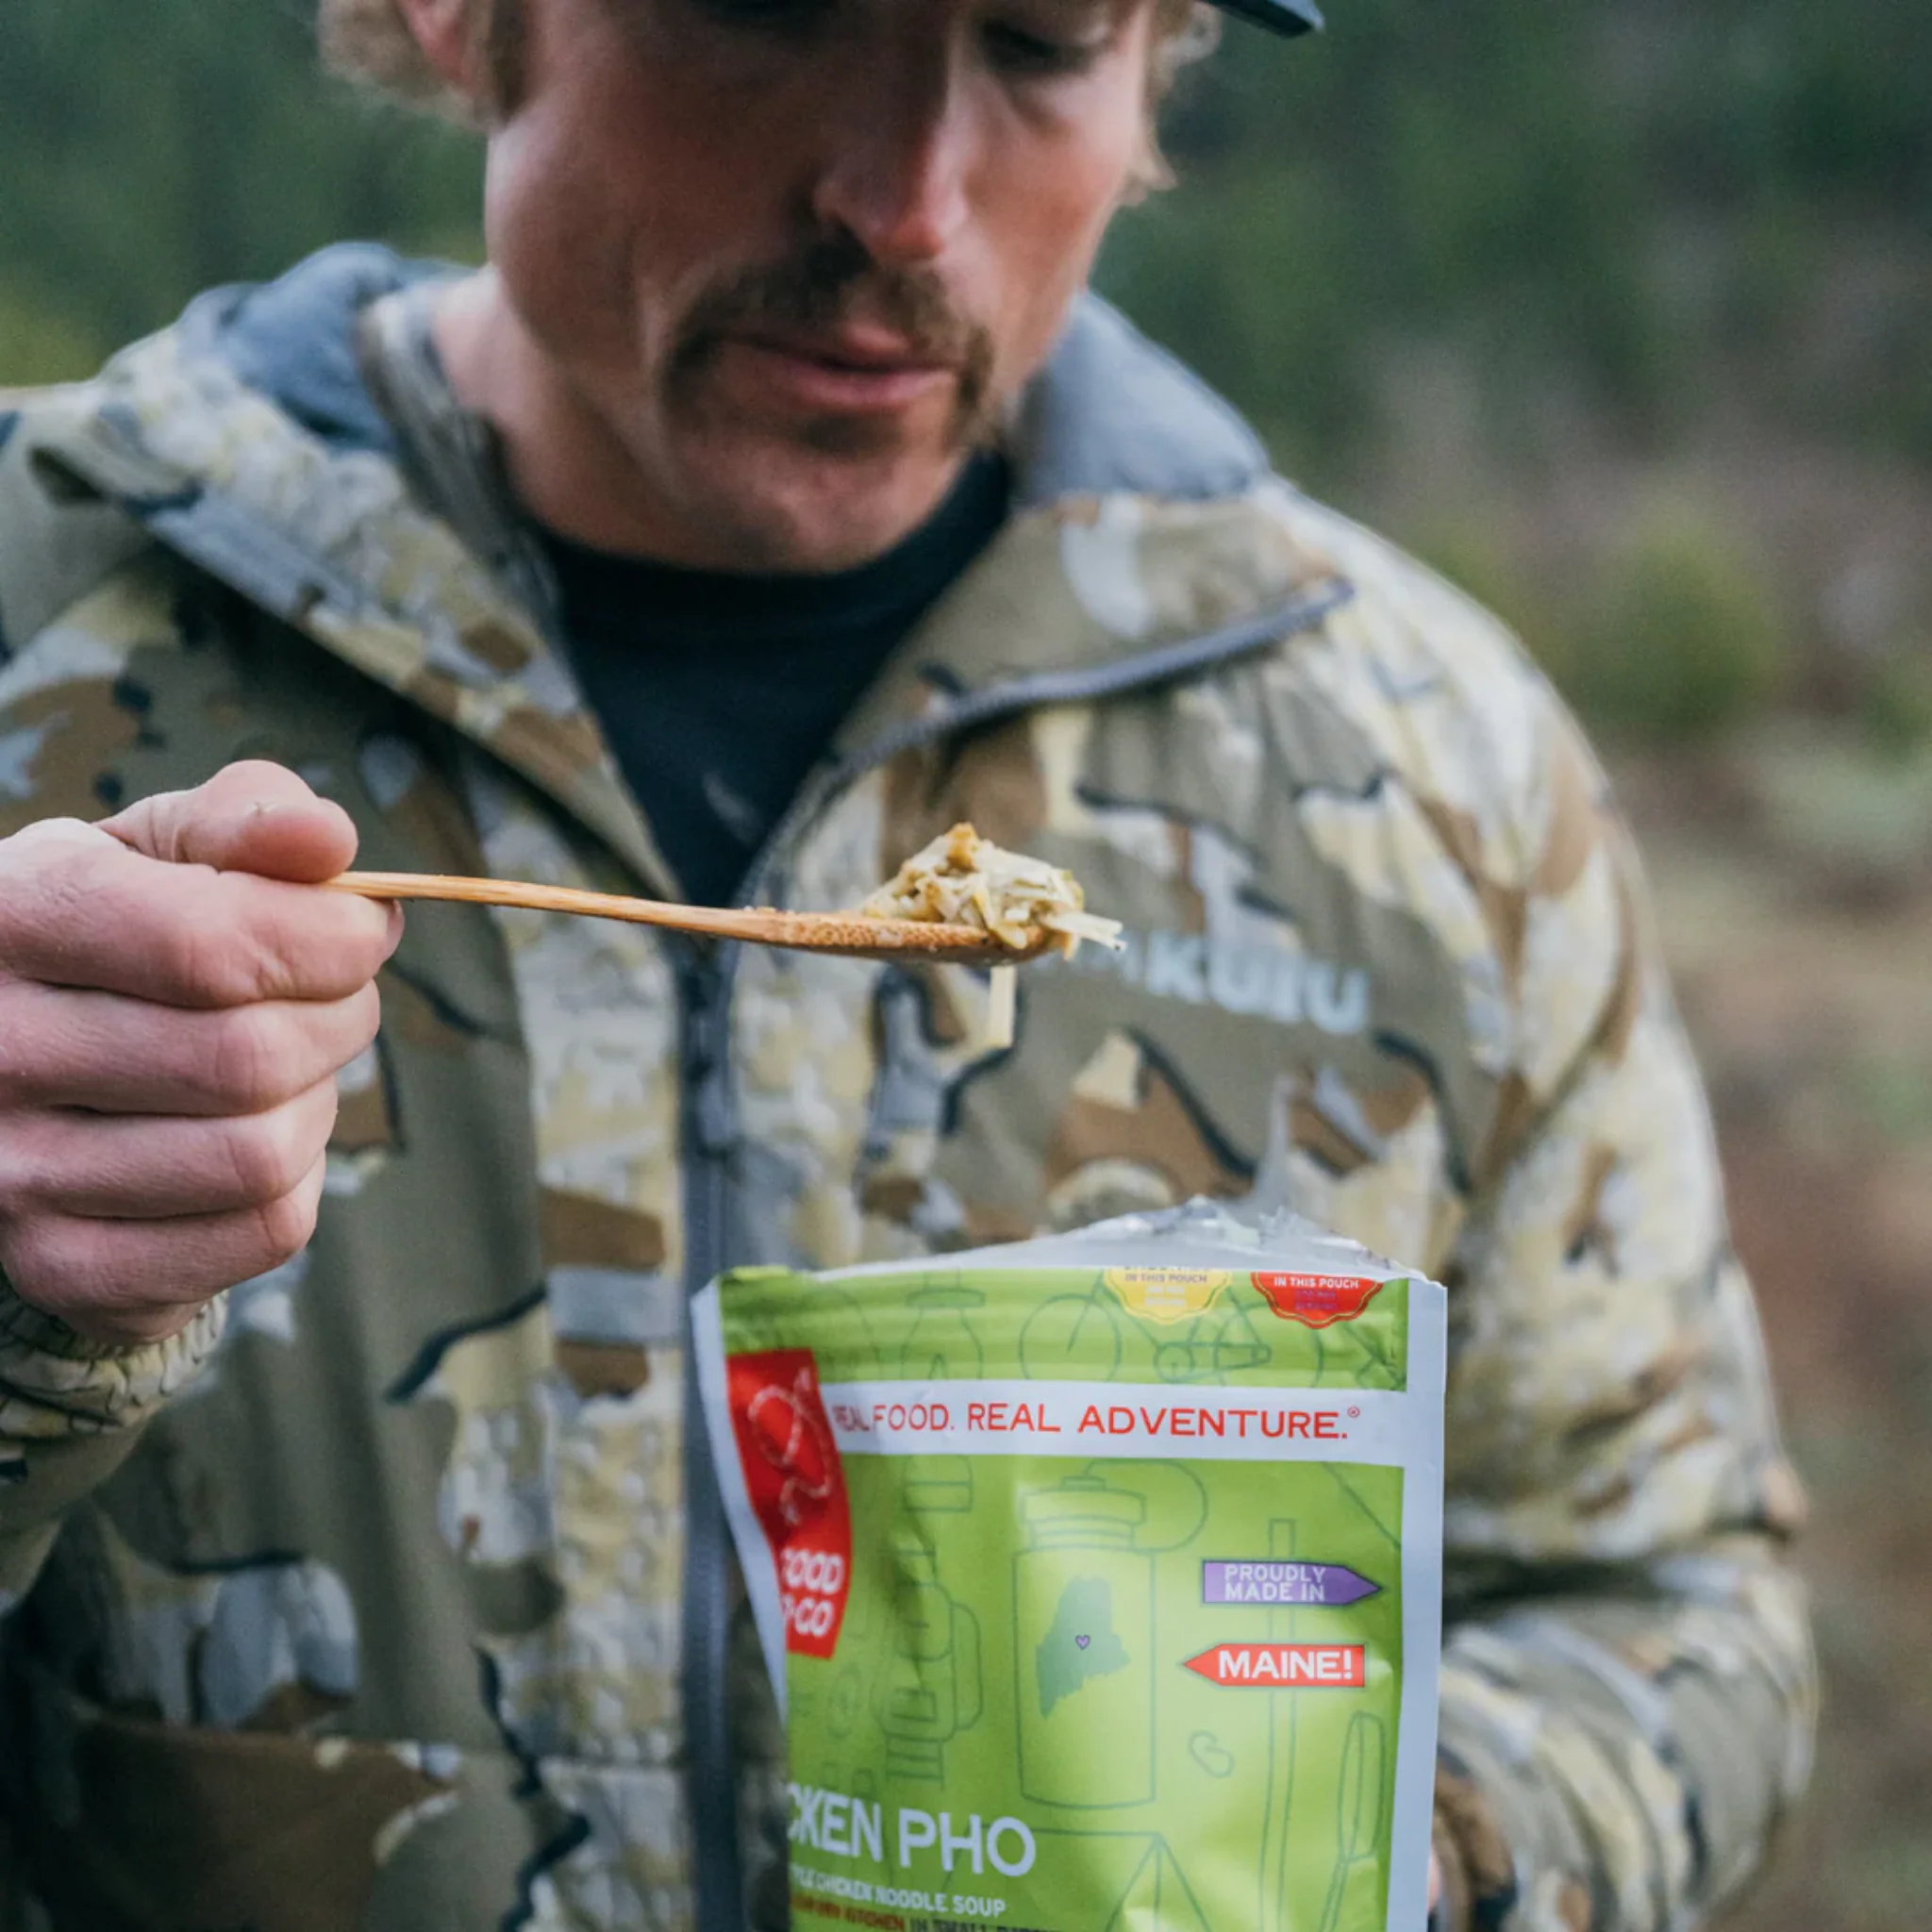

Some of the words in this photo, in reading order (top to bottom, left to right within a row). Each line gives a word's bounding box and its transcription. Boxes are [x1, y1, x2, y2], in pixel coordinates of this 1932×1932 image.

[1141, 1274, 1165, 1283] THIS
[1168, 1274, 1208, 1283] POUCH
[1274, 1275, 1287, 1288] IN
[1290, 1276, 1316, 1289] THIS
[1319, 1278, 1359, 1290] POUCH
[873, 1404, 956, 1432] FOOD.
[967, 1403, 1061, 1433] REAL
[1224, 1564, 1327, 1583] PROUDLY
[1224, 1582, 1293, 1602] MADE
[1301, 1584, 1325, 1602] IN
[1218, 1648, 1353, 1680] MAINE!
[898, 1807, 1037, 1877] PHO
[874, 1885, 948, 1913] NOODLE
[951, 1894, 1007, 1919] SOUP
